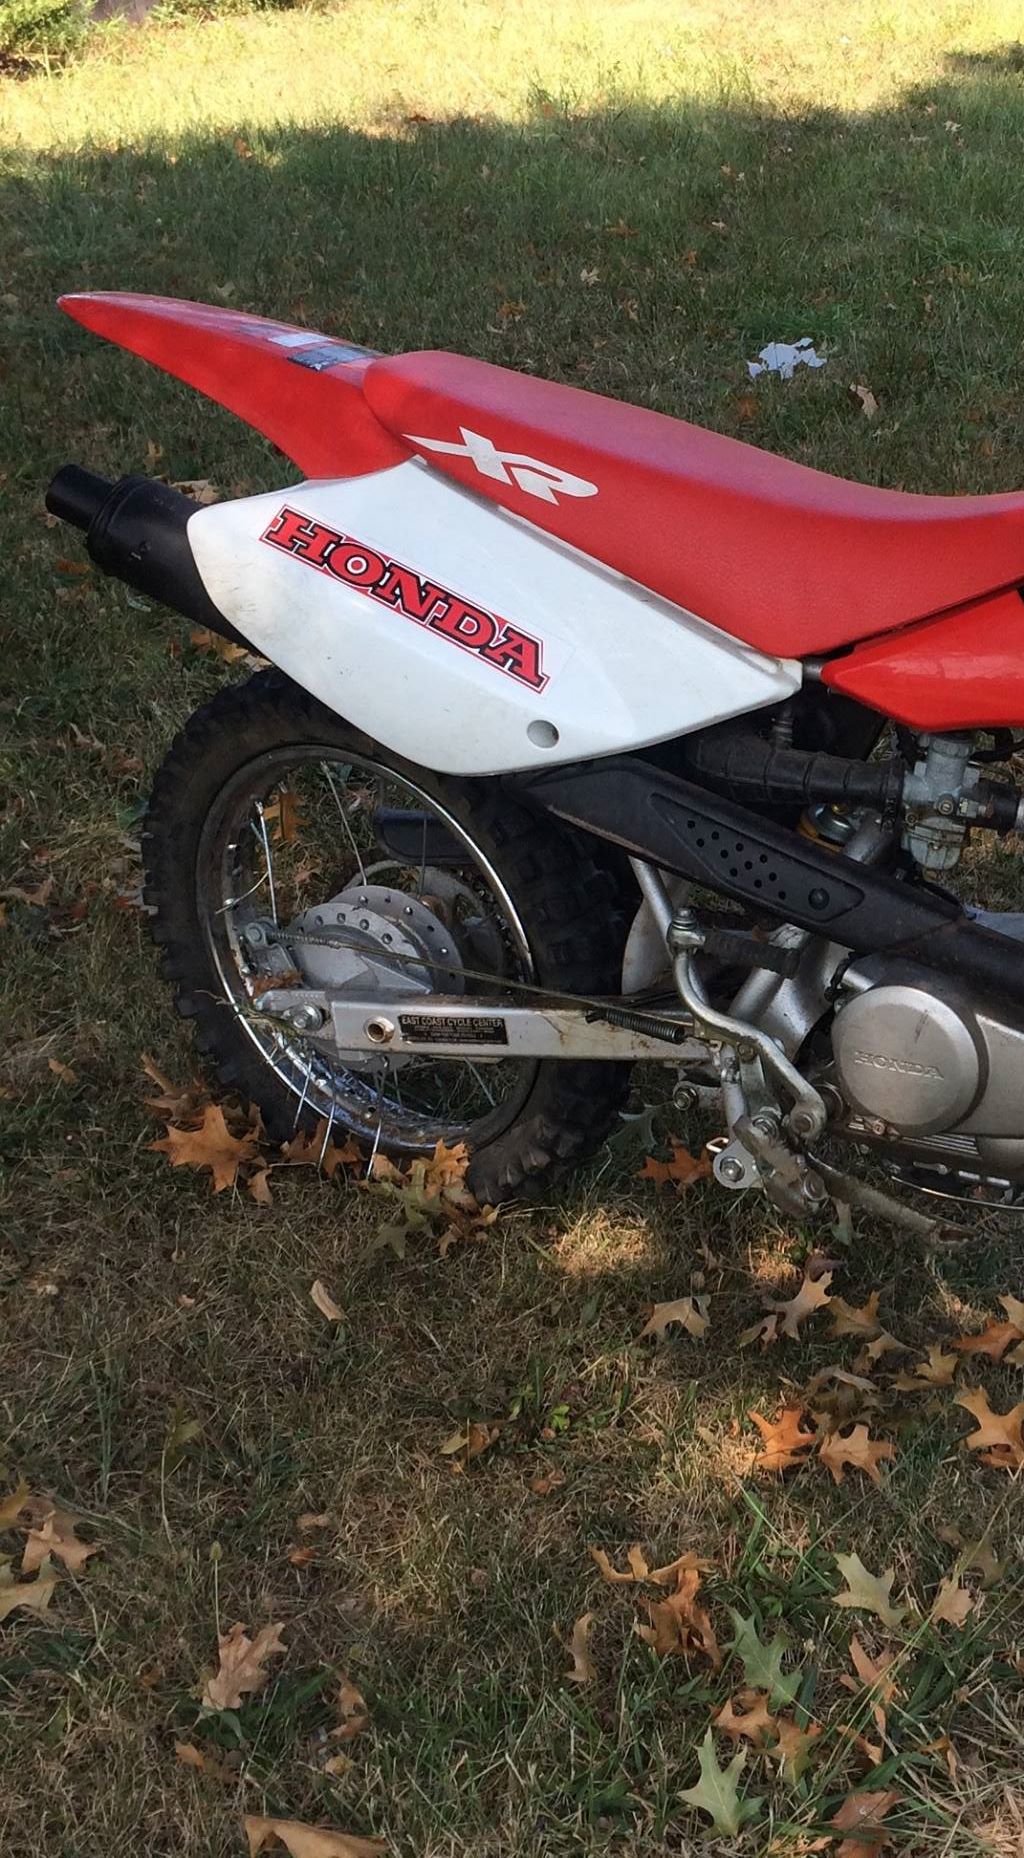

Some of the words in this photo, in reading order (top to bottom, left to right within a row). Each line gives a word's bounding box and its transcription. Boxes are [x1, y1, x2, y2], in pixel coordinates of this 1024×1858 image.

[401, 426, 598, 506] XR
[264, 506, 551, 691] HONDA
[402, 1016, 420, 1025] EAST
[421, 1016, 446, 1027] COAST
[448, 1017, 472, 1027] CYCLE
[474, 1018, 503, 1028] CENTER
[853, 1051, 945, 1081] HONDA
